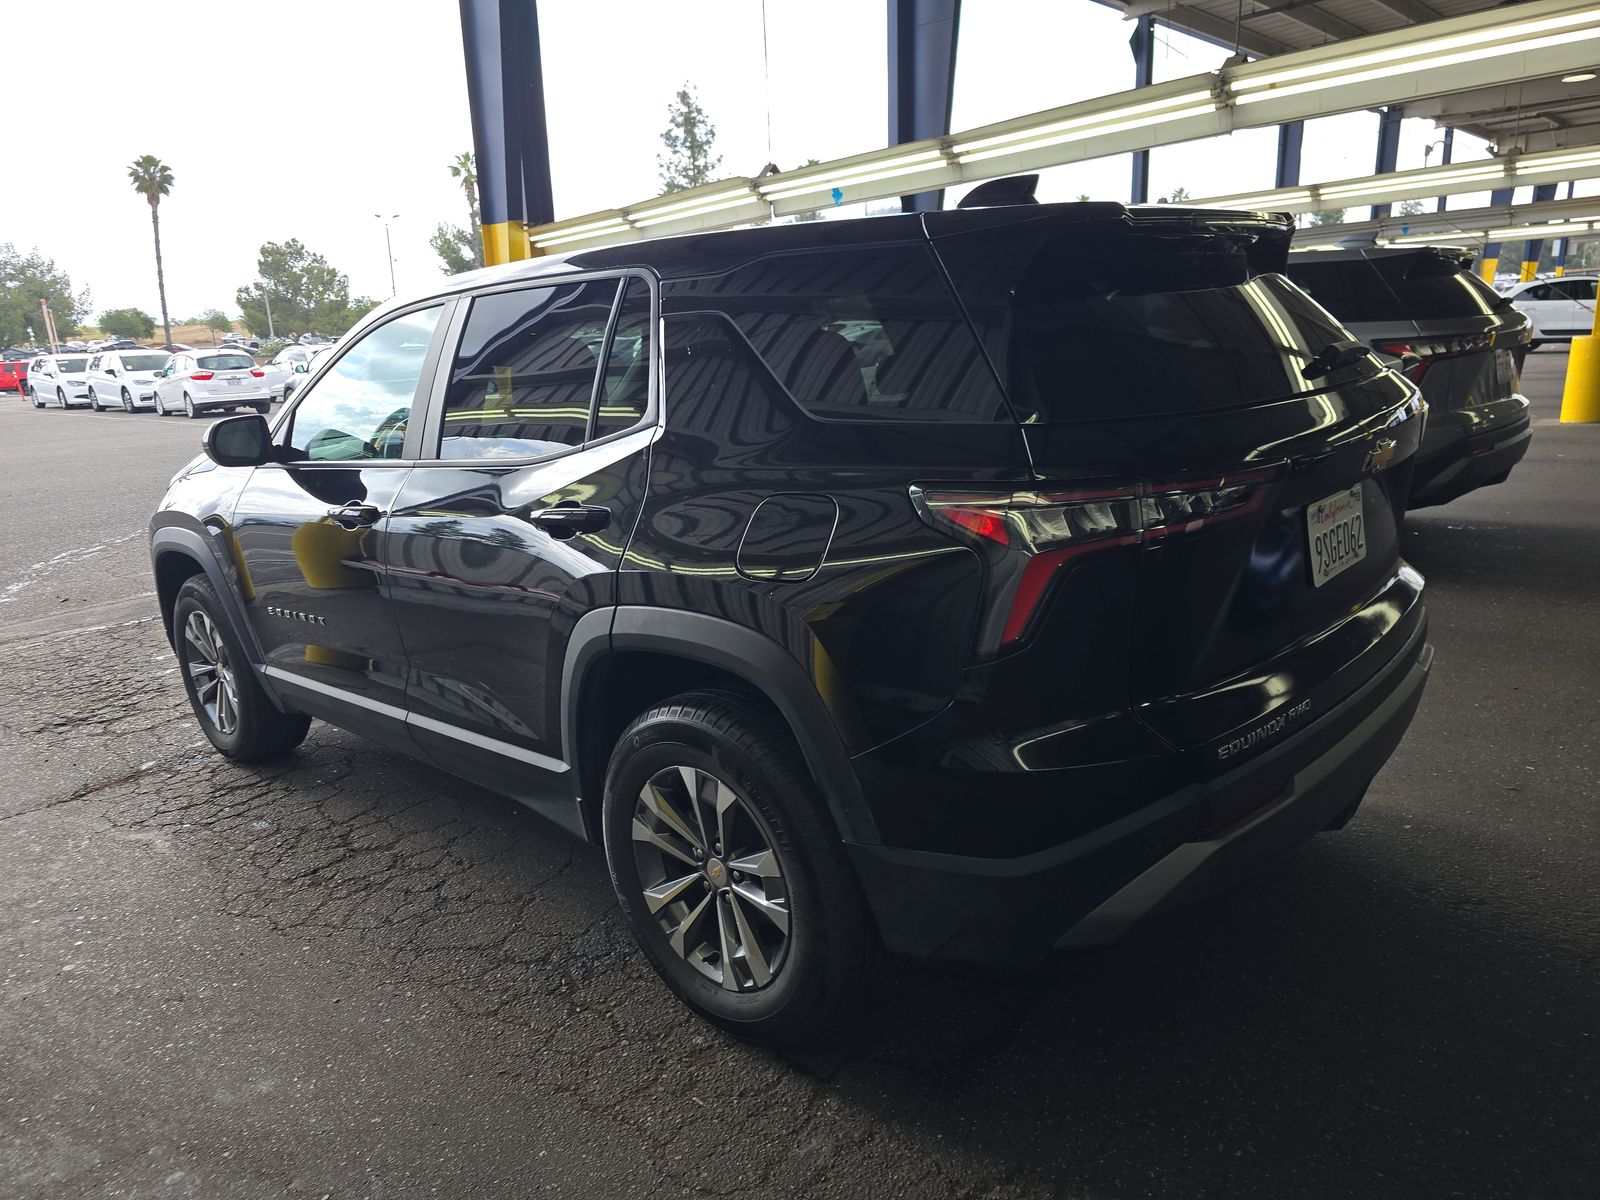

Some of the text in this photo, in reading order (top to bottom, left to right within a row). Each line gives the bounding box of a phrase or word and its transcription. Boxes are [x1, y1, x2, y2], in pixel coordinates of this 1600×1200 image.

[1317, 499, 1354, 524] California
[1315, 513, 1363, 574] 9SGE062
[267, 606, 326, 626] EQUINOX
[1217, 713, 1286, 760] EQUINOX
